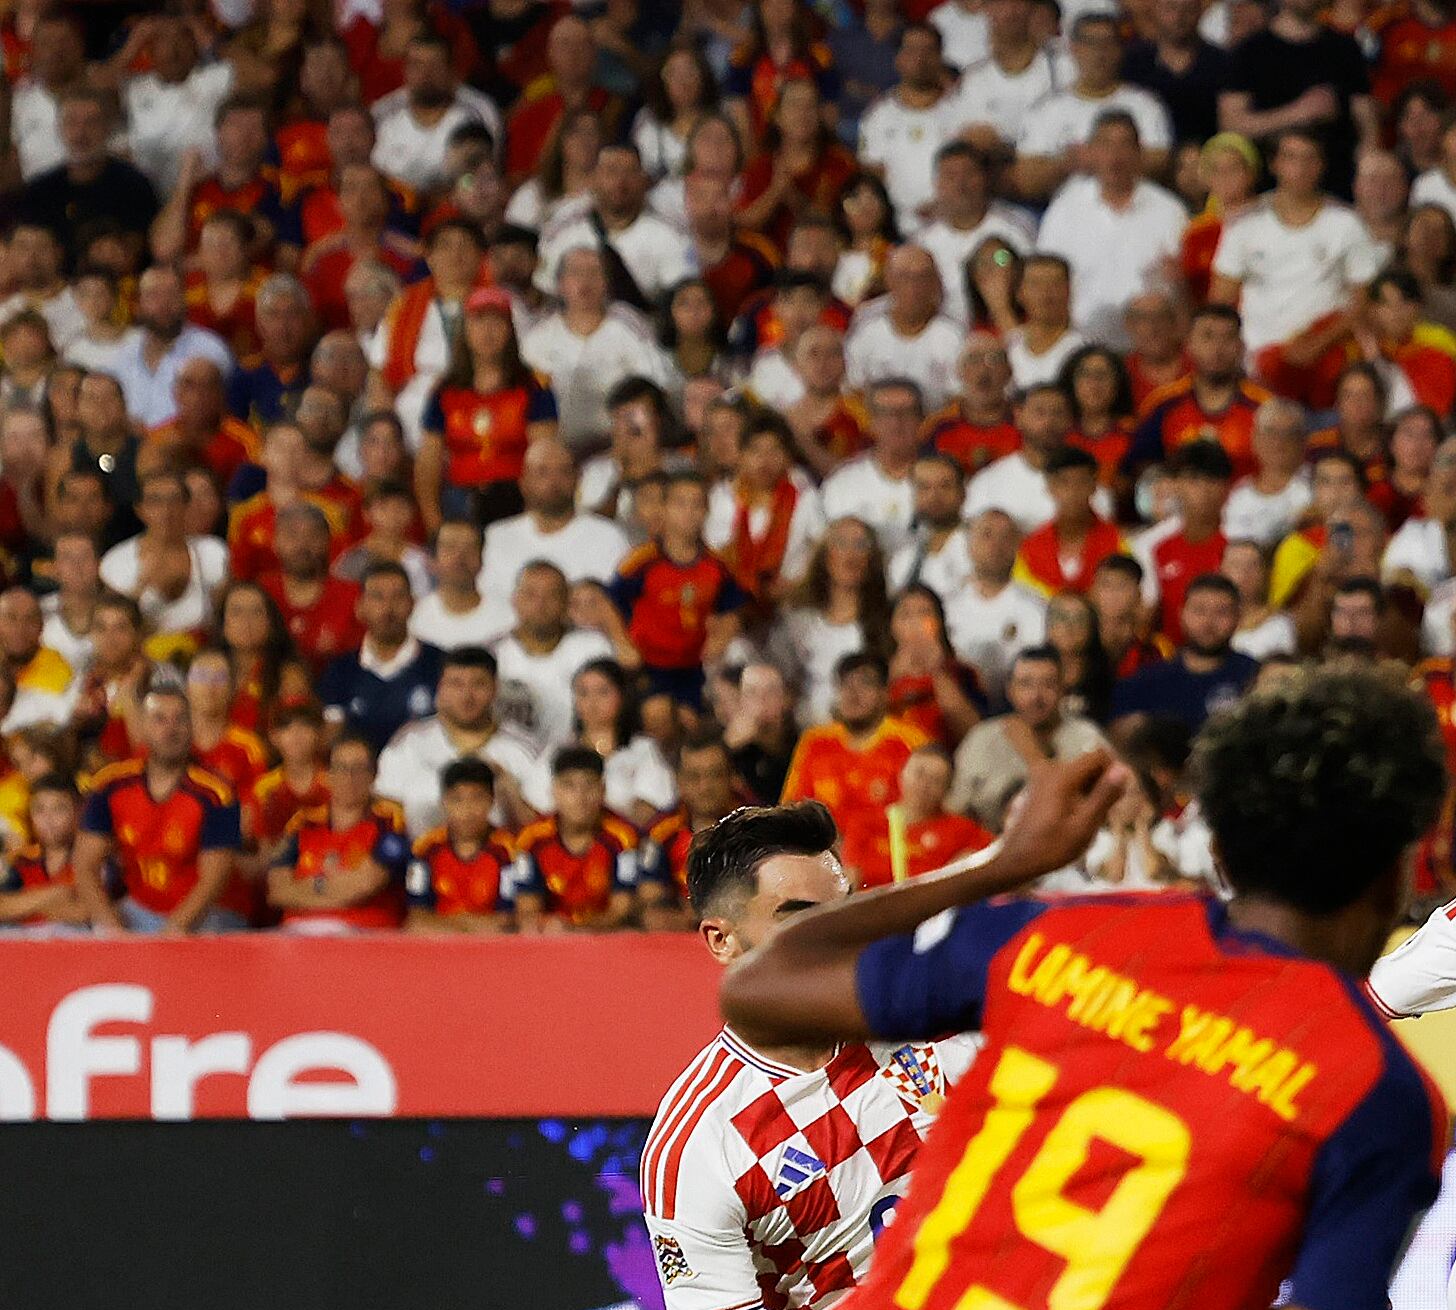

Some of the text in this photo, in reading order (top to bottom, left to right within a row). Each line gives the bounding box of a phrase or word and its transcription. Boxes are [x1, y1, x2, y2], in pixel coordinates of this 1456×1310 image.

[0, 983, 397, 1121] fre
[1008, 932, 1318, 1121] LAMINE YAMAL
